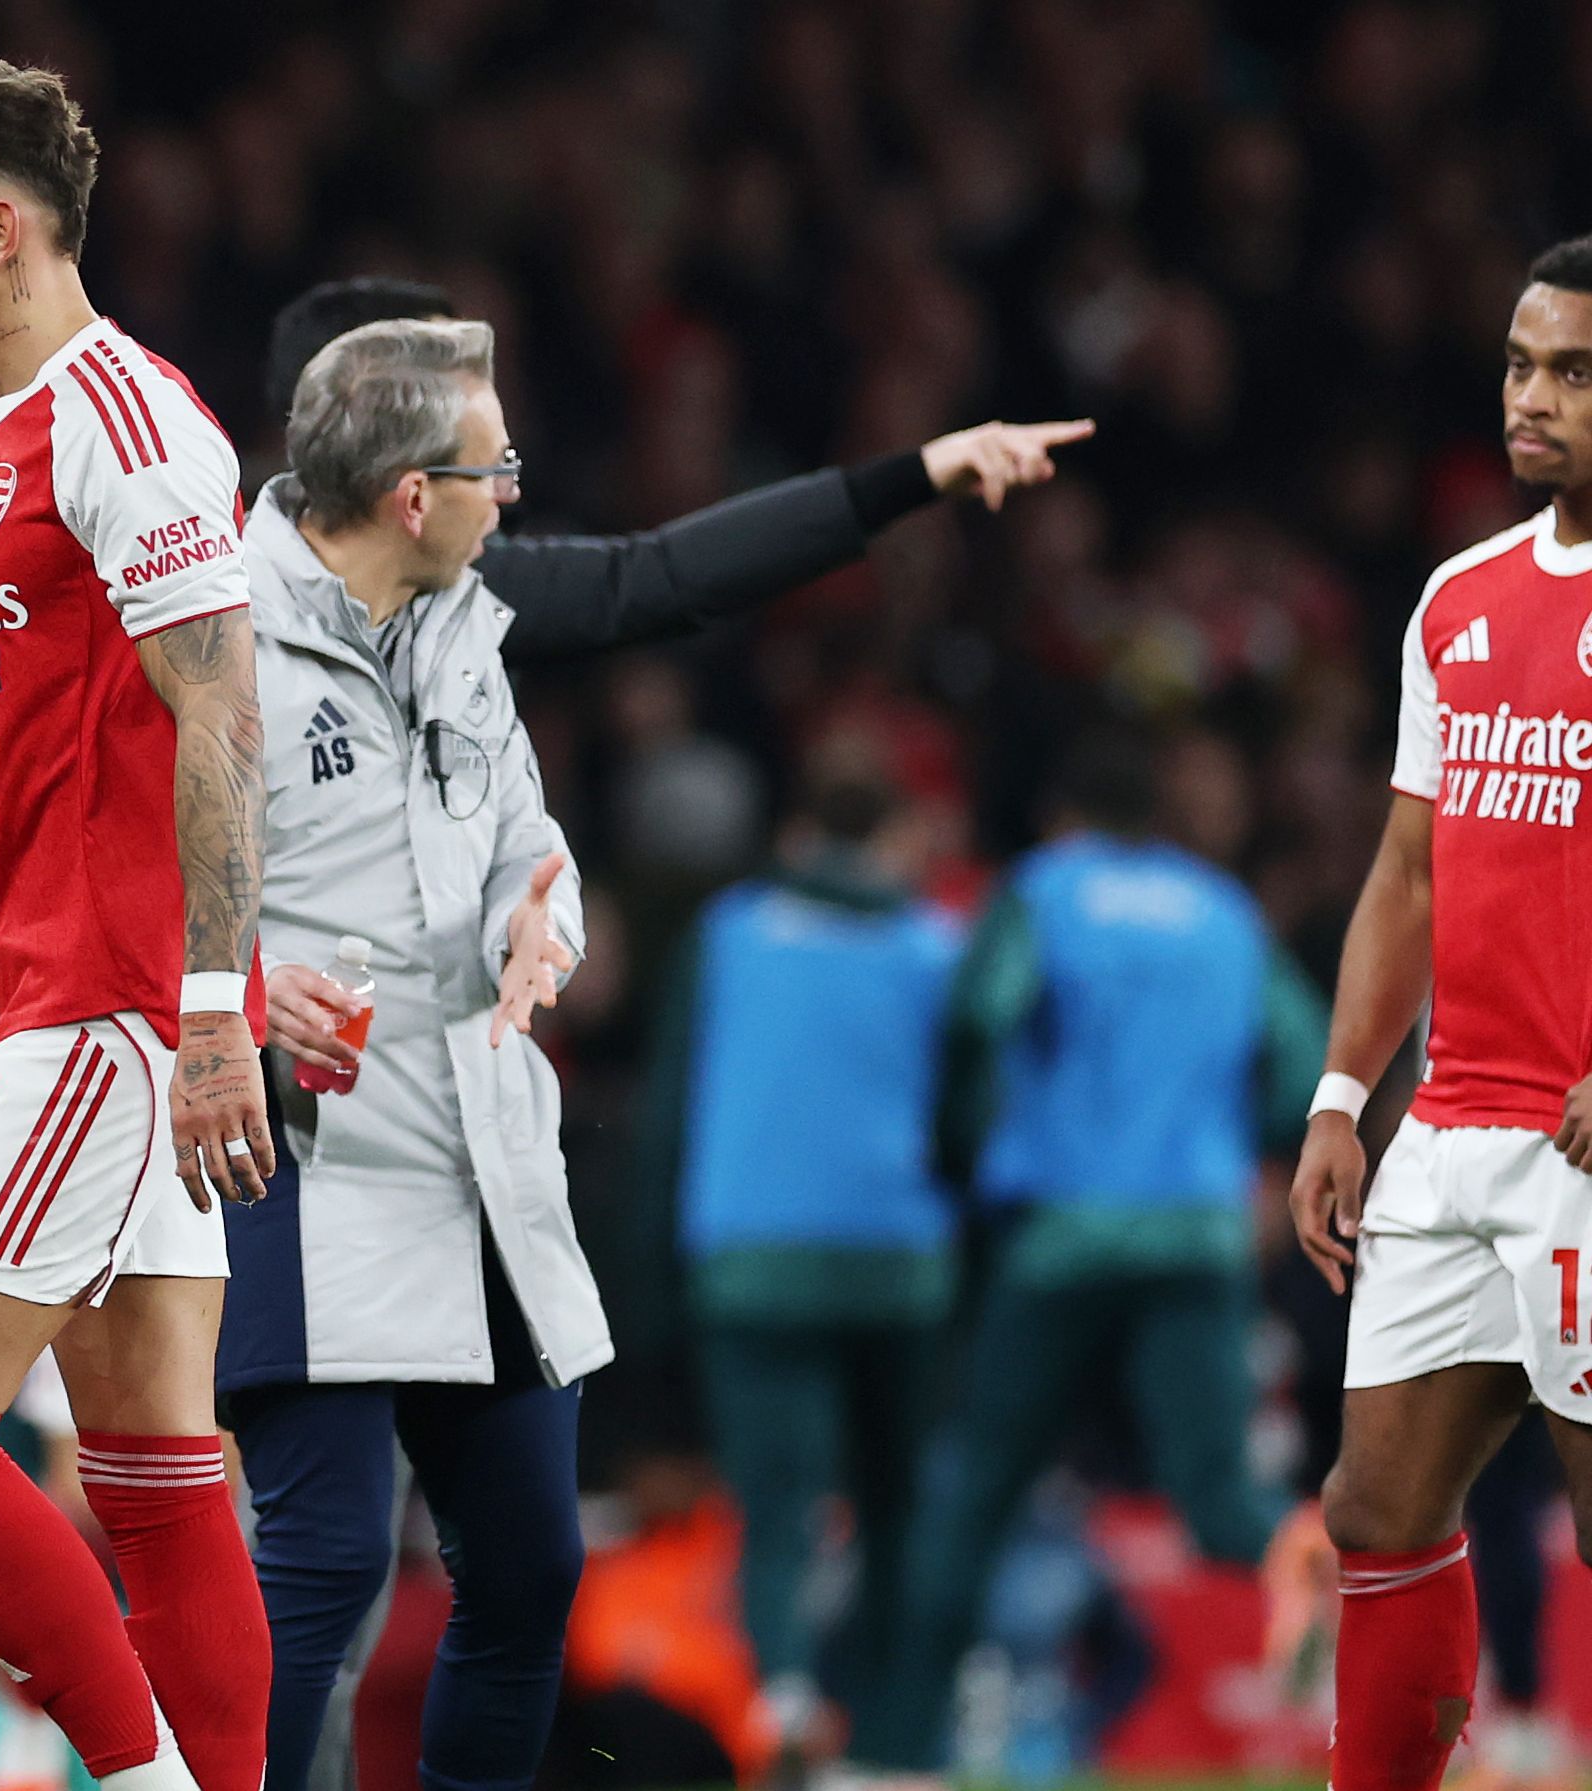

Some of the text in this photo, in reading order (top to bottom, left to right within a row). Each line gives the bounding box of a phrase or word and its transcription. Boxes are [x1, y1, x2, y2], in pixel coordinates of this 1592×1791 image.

[121, 534, 235, 589] RWANDA
[136, 515, 201, 554] VISIT
[312, 736, 355, 784] AS
[1476, 768, 1582, 828] BETTER
[1551, 1248, 1592, 1345] 1
